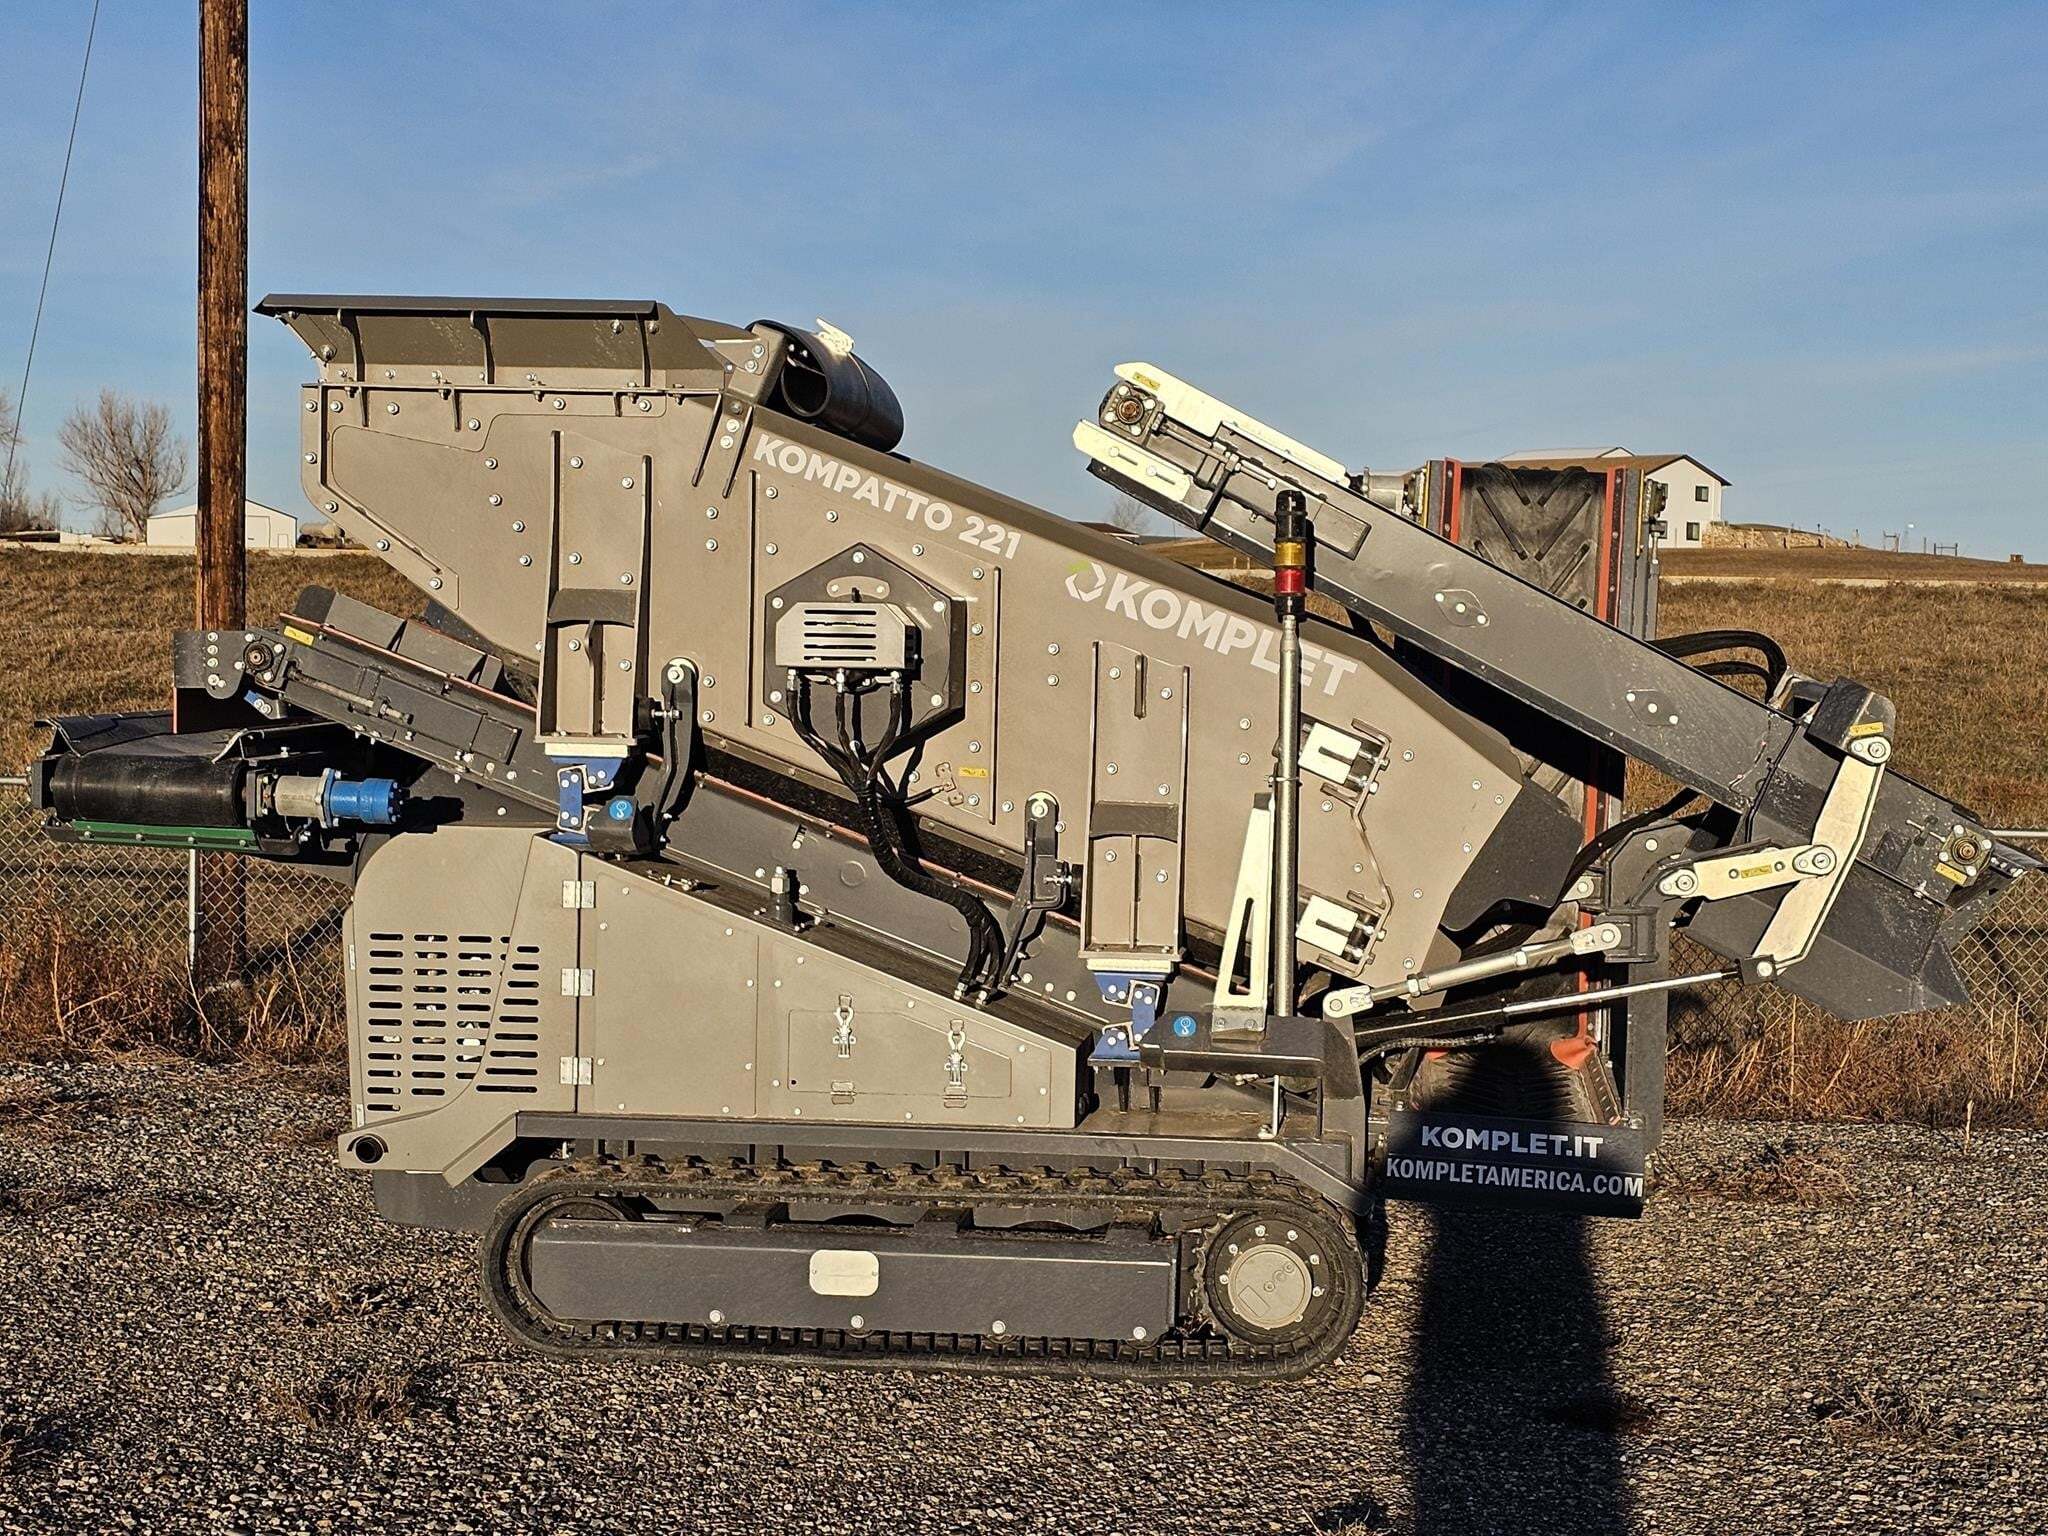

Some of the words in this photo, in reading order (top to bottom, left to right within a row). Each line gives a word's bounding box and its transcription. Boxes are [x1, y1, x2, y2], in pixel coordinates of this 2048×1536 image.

[753, 433, 952, 531] KOMPATTO
[958, 515, 1022, 559] 221
[1421, 1125, 1604, 1159] KOMPLET.IT
[1386, 1157, 1644, 1198] KOMPLETAMERICA.COM
